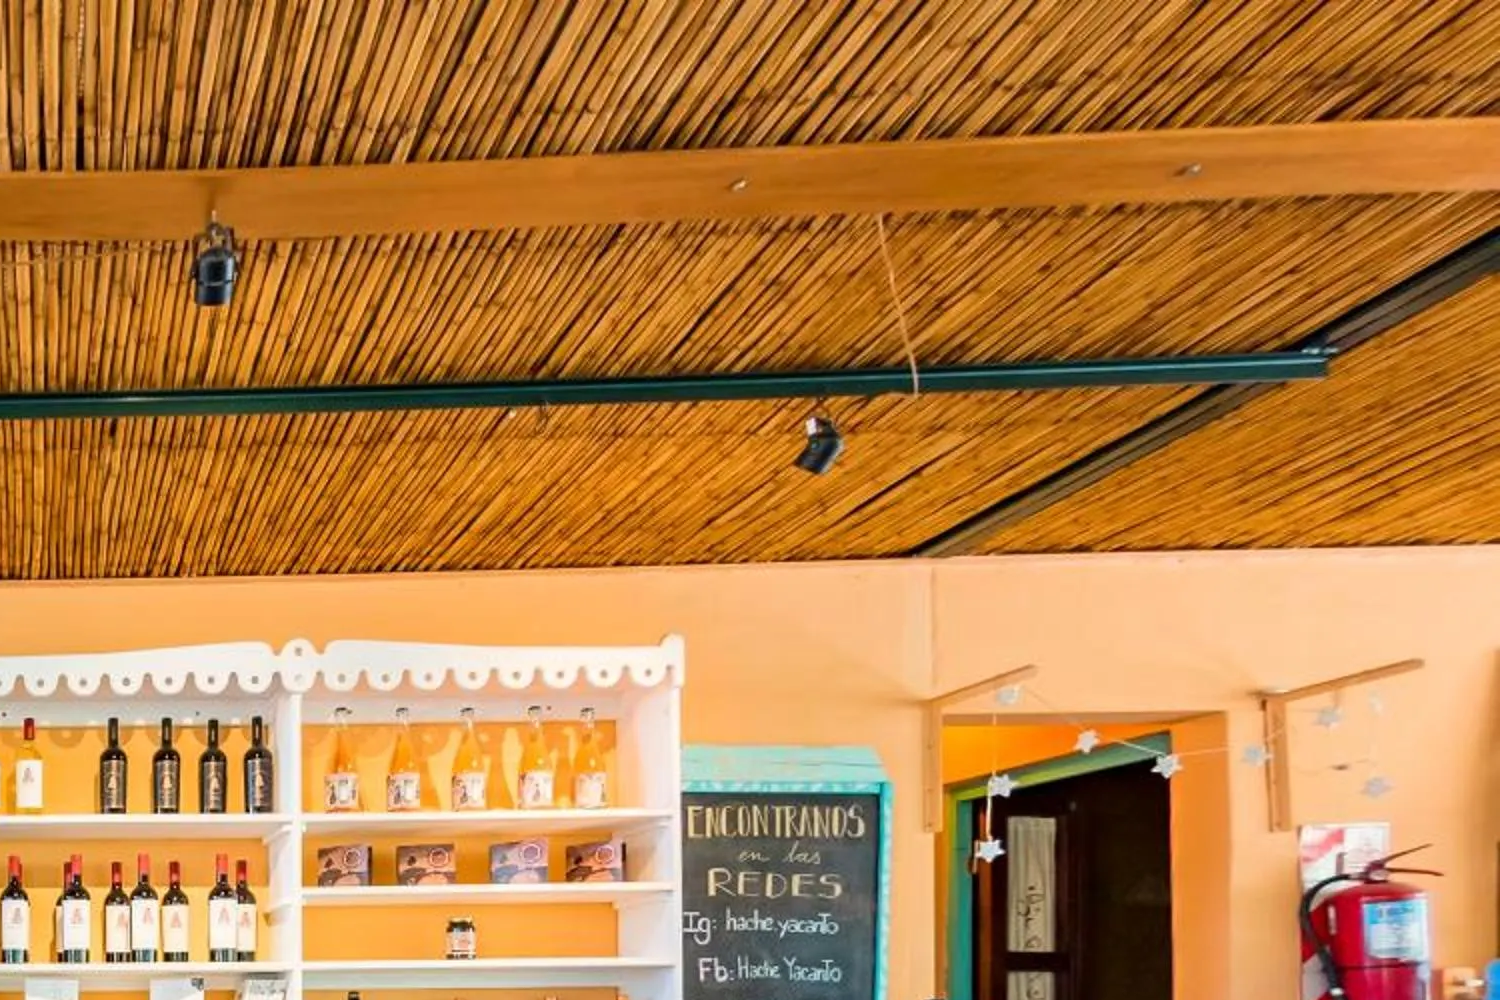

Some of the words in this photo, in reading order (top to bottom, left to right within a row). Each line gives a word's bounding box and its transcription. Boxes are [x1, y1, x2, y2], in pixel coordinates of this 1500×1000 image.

[687, 803, 866, 839] ENCONTRANOS
[738, 850, 771, 863] en
[782, 840, 822, 865] las
[706, 867, 843, 900] REDES
[683, 911, 718, 945] Ig:
[698, 956, 735, 983] Fb:
[737, 954, 781, 980] Hache
